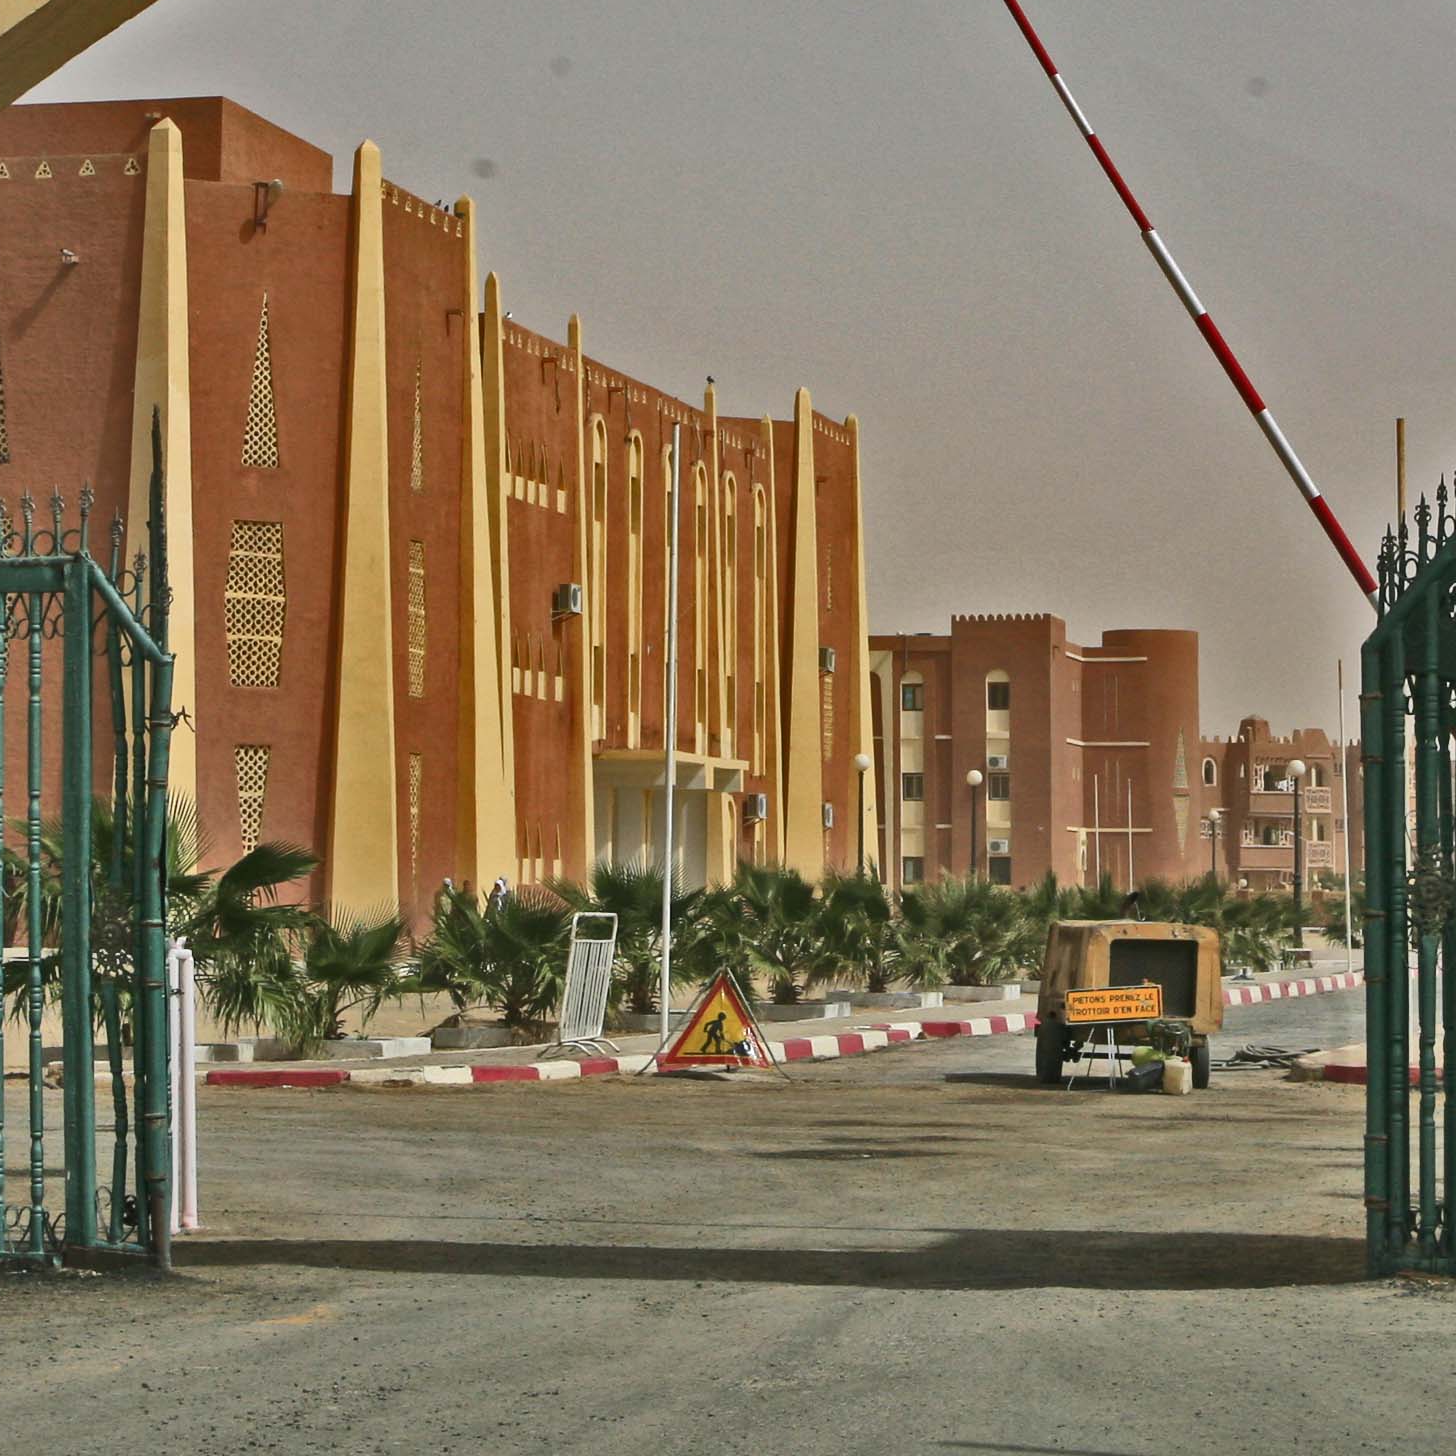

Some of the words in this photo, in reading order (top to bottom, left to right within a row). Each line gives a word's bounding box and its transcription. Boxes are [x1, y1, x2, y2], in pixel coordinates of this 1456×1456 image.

[1072, 996, 1105, 1005] PIETONS
[1144, 993, 1154, 1001] LE
[1072, 1007, 1110, 1016] TROTTOIR
[1135, 1005, 1156, 1013] FACE
